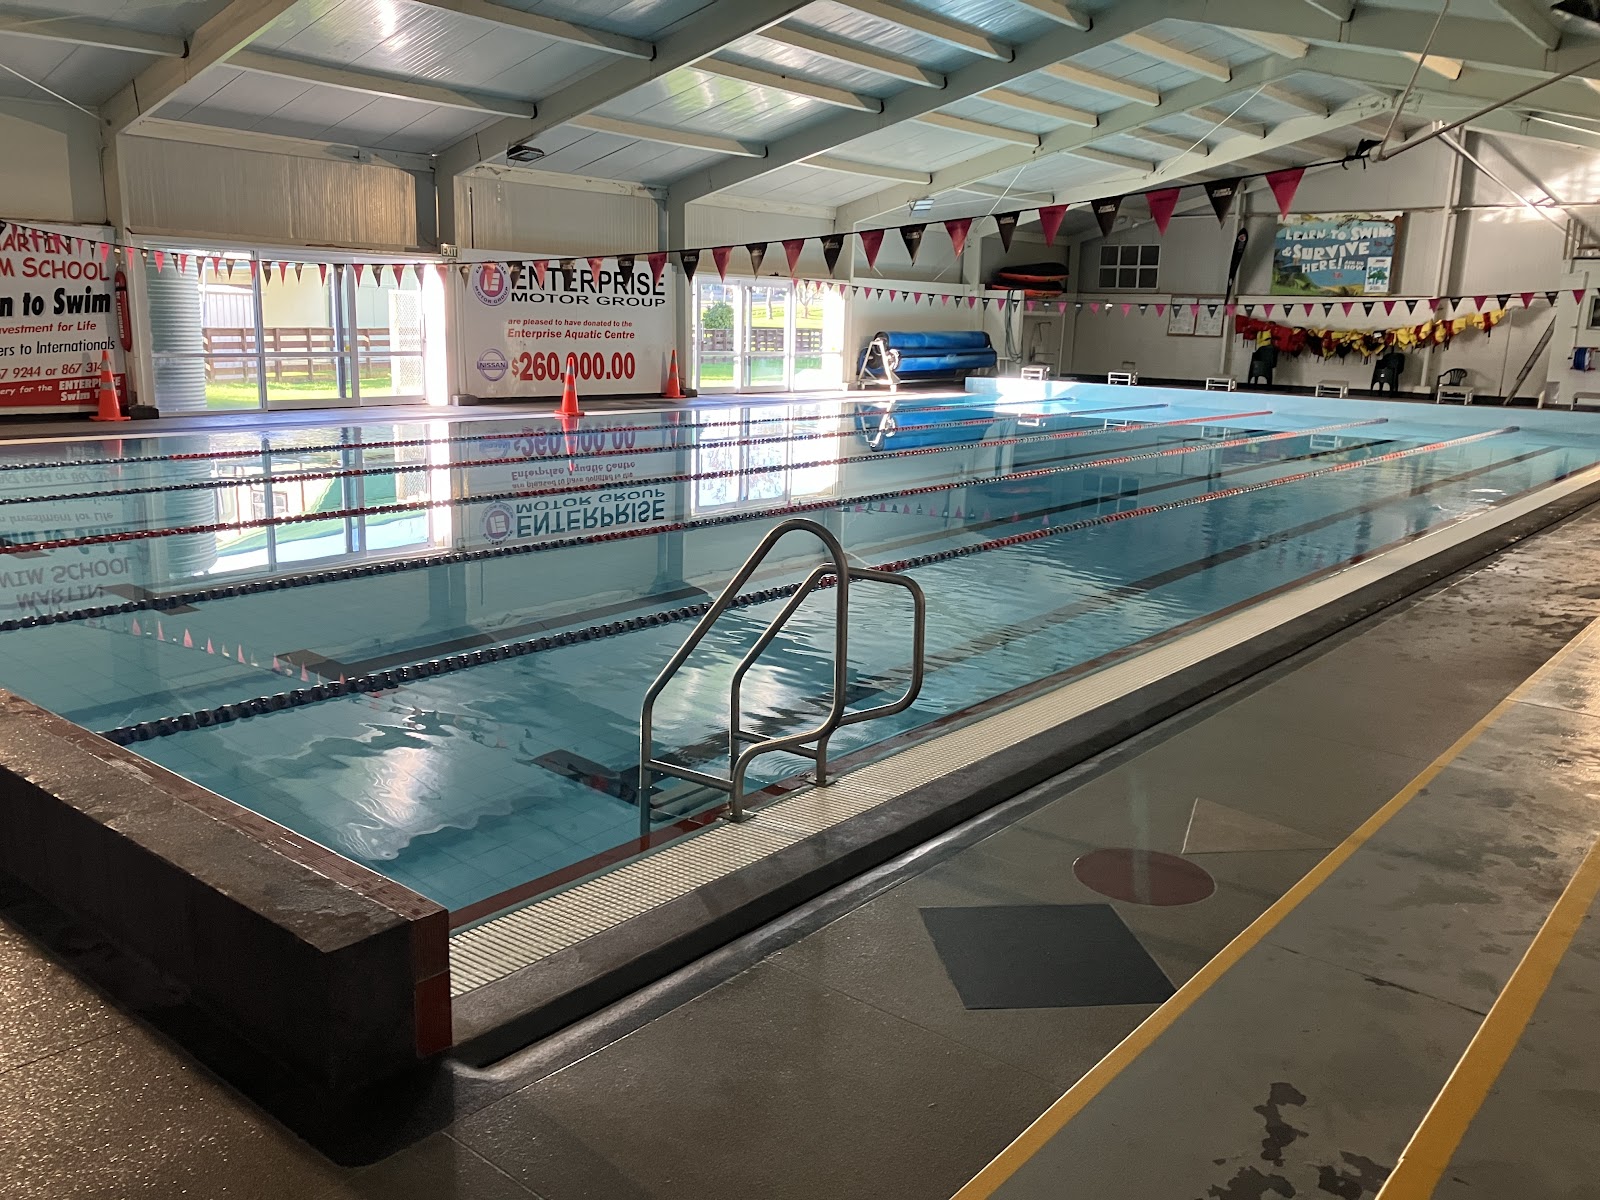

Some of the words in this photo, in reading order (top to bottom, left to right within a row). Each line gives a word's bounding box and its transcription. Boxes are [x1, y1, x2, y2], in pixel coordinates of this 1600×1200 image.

[1285, 228, 1327, 241] LEARN
[1330, 229, 1347, 241] TO
[1350, 226, 1394, 241] SWIM
[0, 233, 72, 255] ARTIN
[1292, 241, 1370, 261] SURVIVE
[442, 247, 457, 257] EXIT
[22, 256, 110, 281] SCHOOL
[1301, 258, 1342, 273] HERE!
[512, 266, 665, 296] ENTERPRISE
[23, 292, 44, 316] to
[54, 285, 111, 315] Swim
[511, 292, 590, 305] MOTOR
[596, 295, 666, 307] GROUP
[58, 321, 74, 332] for
[77, 320, 97, 331] Life
[522, 318, 553, 326] pleased
[583, 319, 612, 327] donated
[507, 328, 562, 340] Enterprise
[564, 329, 602, 340] Aquatic
[604, 329, 635, 339] Centre
[20, 343, 32, 355] to
[36, 336, 116, 354] Internationals
[13, 366, 41, 379] 9244
[45, 367, 58, 376] or
[61, 362, 83, 375] 867
[511, 351, 636, 383] $260,000.00
[19, 385, 34, 394] for
[38, 384, 53, 392] the
[60, 390, 91, 402] Swim
